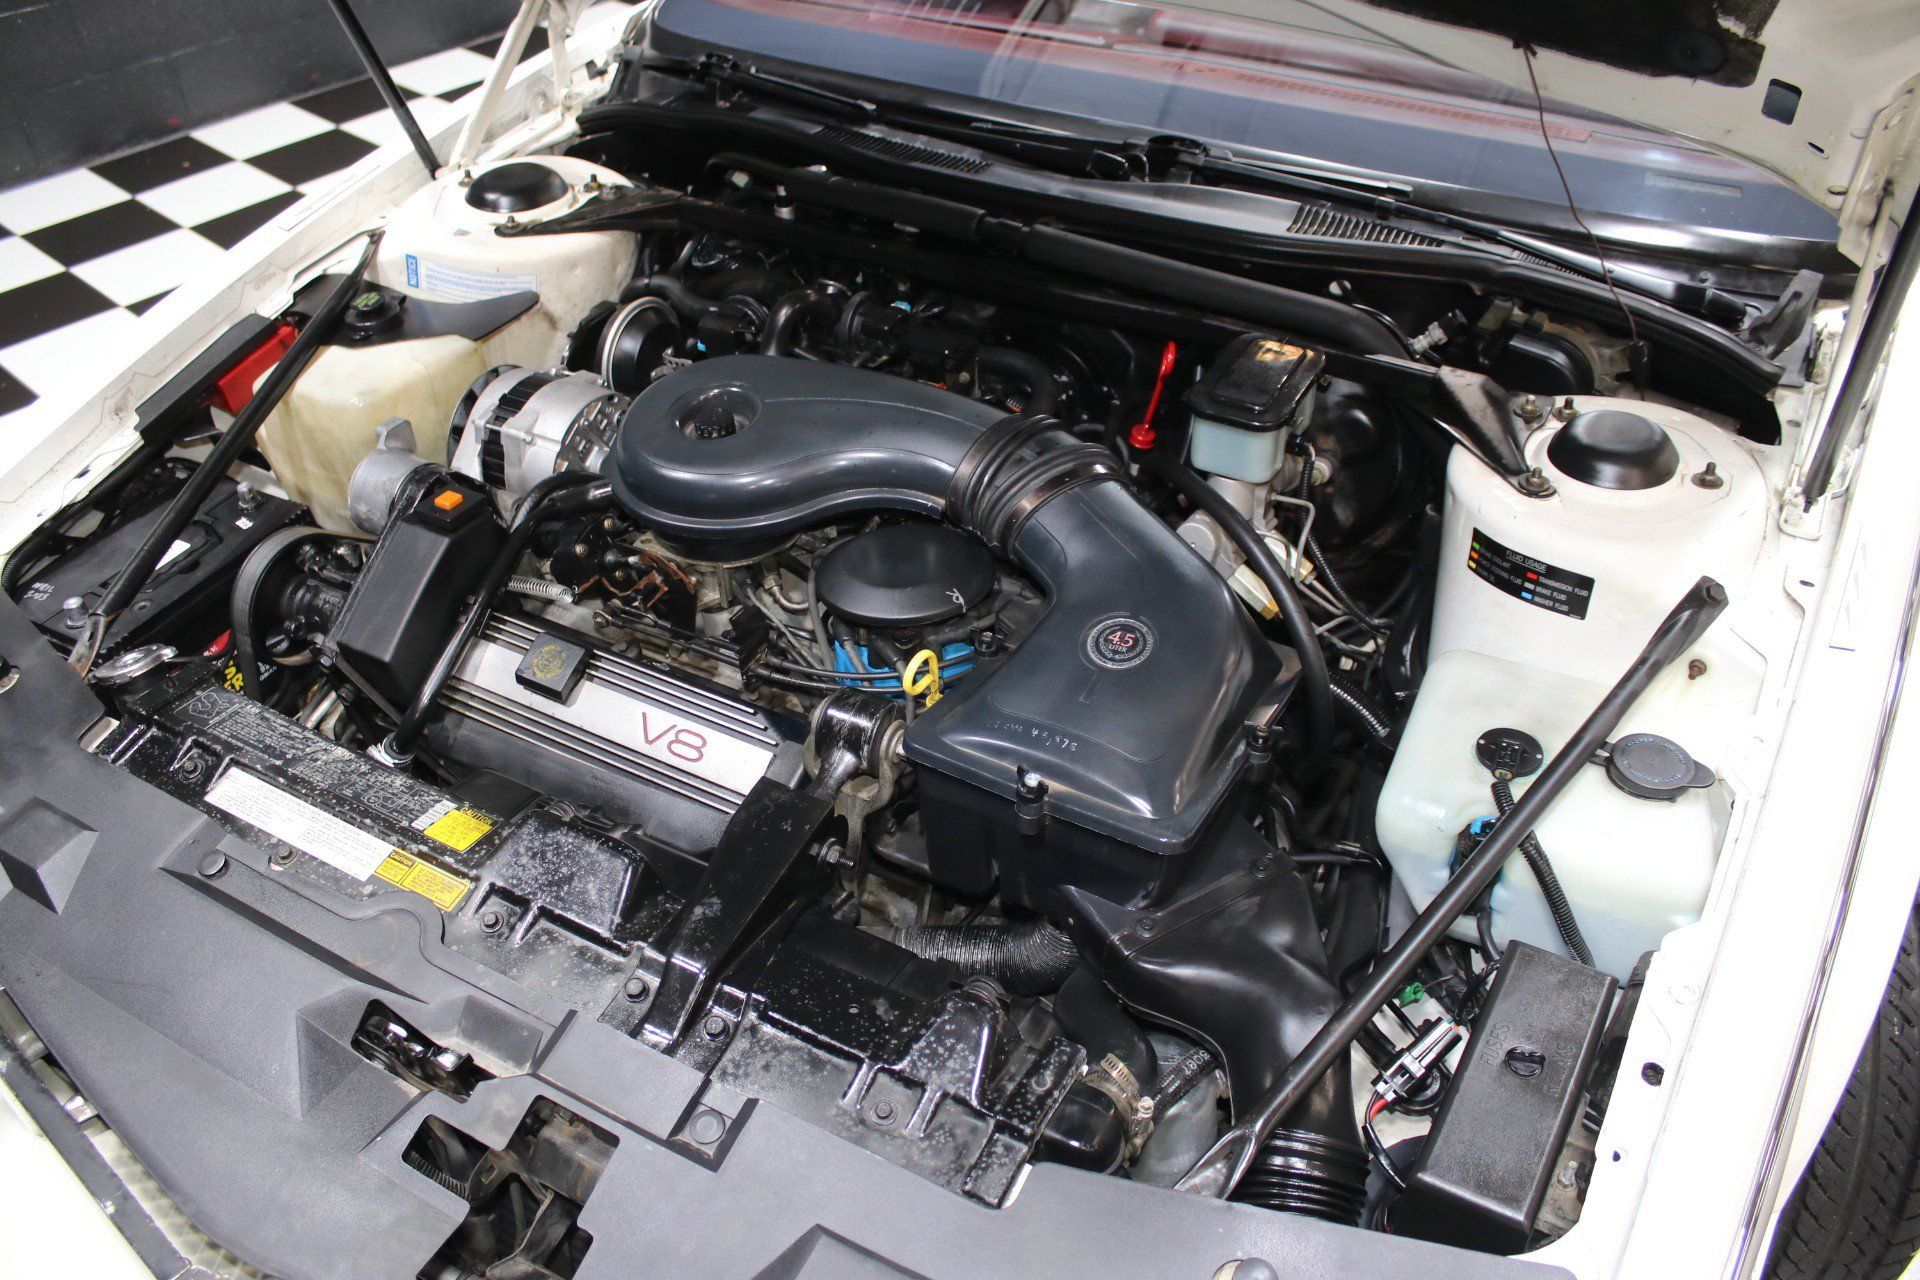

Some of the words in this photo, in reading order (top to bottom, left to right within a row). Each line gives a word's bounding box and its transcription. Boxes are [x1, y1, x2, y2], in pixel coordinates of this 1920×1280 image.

[1506, 550, 1524, 562] FLUID
[1525, 557, 1547, 571] USAGE
[1510, 575, 1523, 586] FLUID
[1538, 576, 1573, 592] TRANSMISSION
[1574, 587, 1589, 597] FLUID
[1535, 585, 1552, 597] BRAKE
[1553, 591, 1567, 601] FLUID
[1533, 596, 1554, 608] WASHER
[1555, 602, 1569, 612] FLUID
[1107, 630, 1135, 646] 4.5
[1108, 643, 1128, 653] LITER
[642, 711, 707, 763] V8
[460, 806, 495, 826] CAUTION
[389, 851, 415, 869] CAUTION
[1480, 1022, 1511, 1067] FUSES
